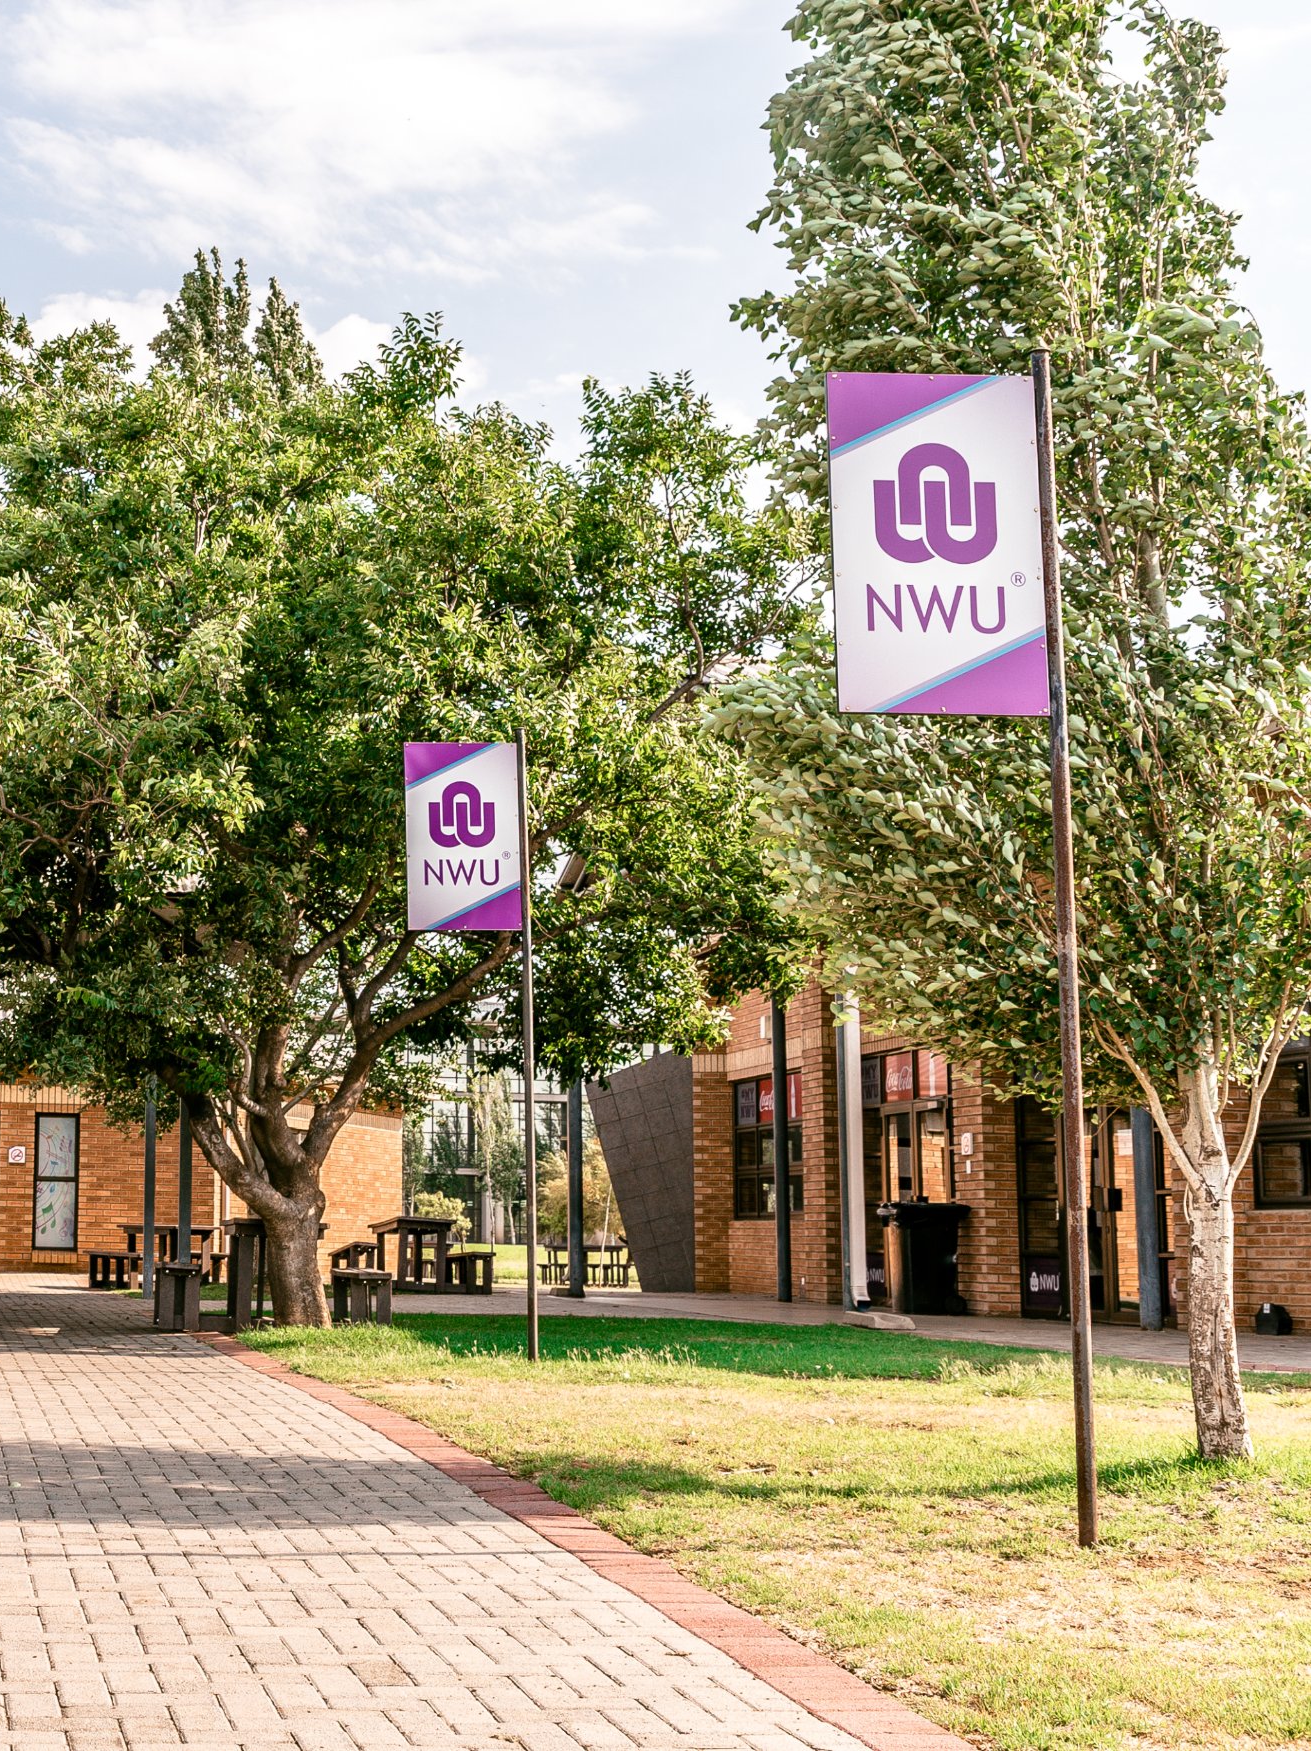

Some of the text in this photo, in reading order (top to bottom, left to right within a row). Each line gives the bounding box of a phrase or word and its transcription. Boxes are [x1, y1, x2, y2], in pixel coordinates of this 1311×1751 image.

[866, 583, 1006, 634] NWU
[424, 859, 500, 886] NWU
[1039, 1274, 1060, 1292] NWU
